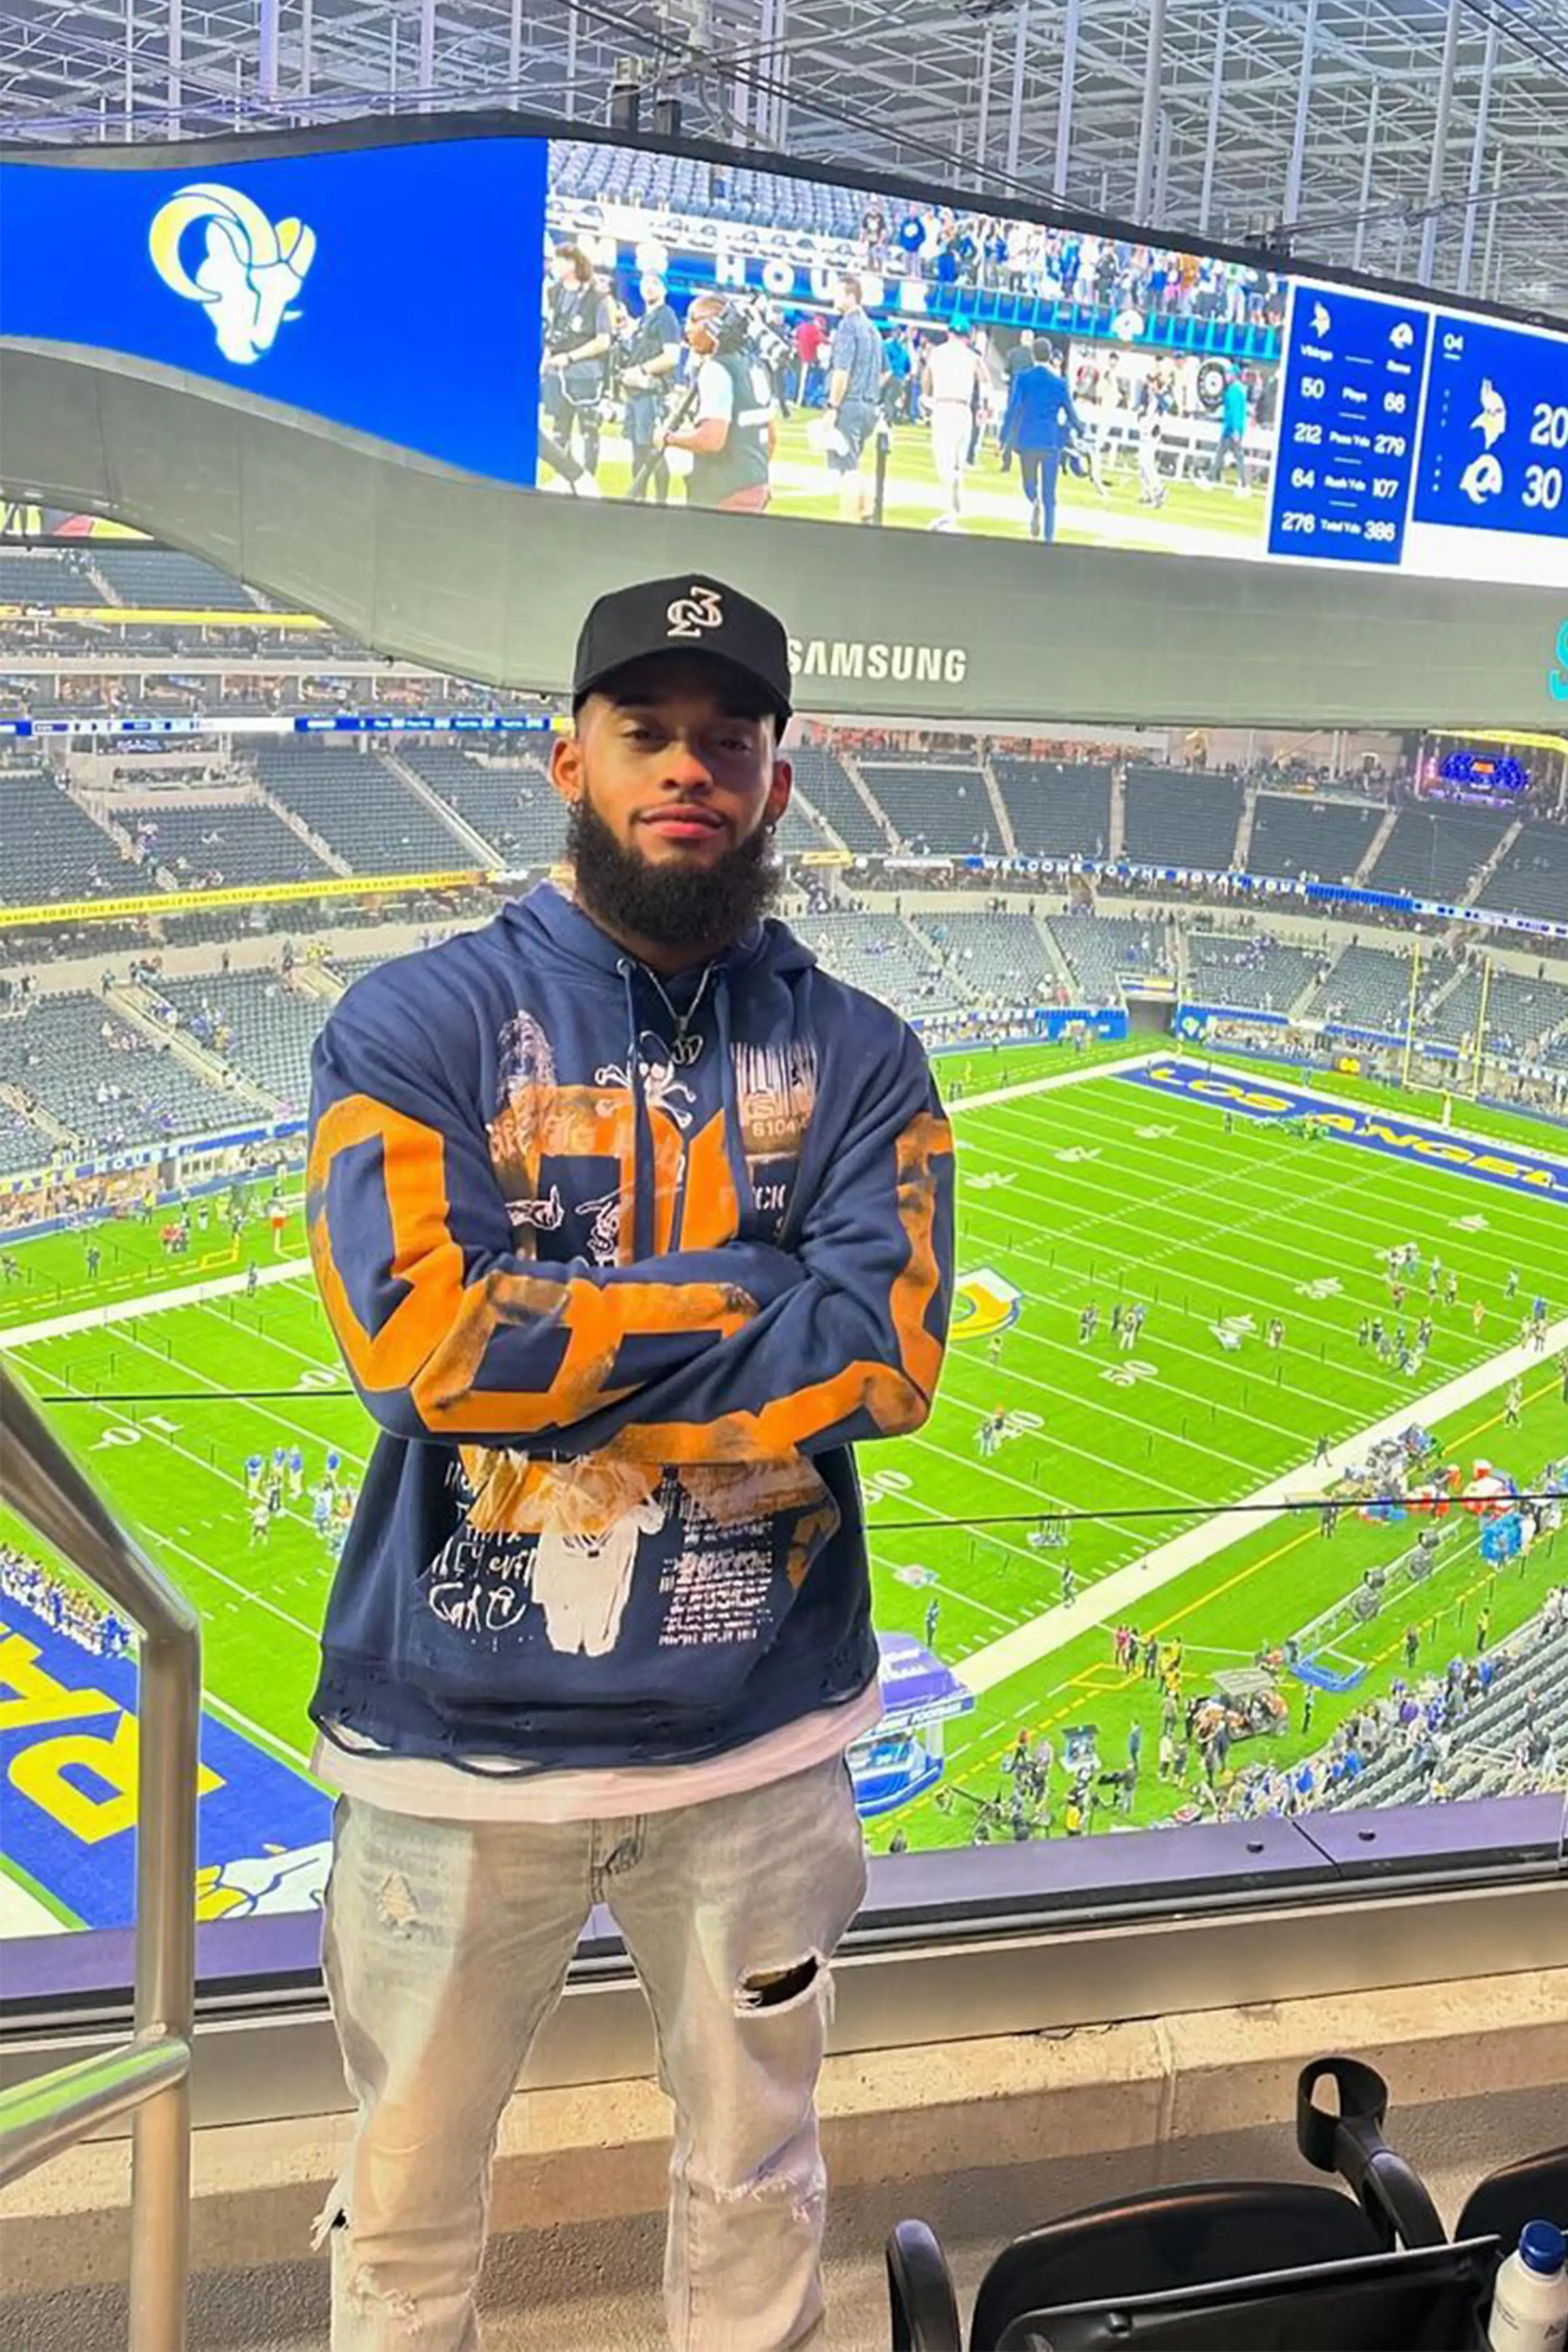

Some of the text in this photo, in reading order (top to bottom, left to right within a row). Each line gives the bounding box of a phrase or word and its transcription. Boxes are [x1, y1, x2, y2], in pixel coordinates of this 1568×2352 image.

[1301, 376, 1326, 399] 50
[1293, 422, 1323, 445] 212
[1373, 433, 1406, 457] 279
[1530, 402, 1568, 449] 20
[1291, 467, 1316, 490] 64
[1373, 478, 1400, 499] 107
[1521, 463, 1563, 510] 30
[1281, 510, 1316, 534] 276
[787, 638, 967, 683] SAMSUNG
[1149, 1066, 1297, 1113] LOS
[1098, 1360, 1160, 1387] 50
